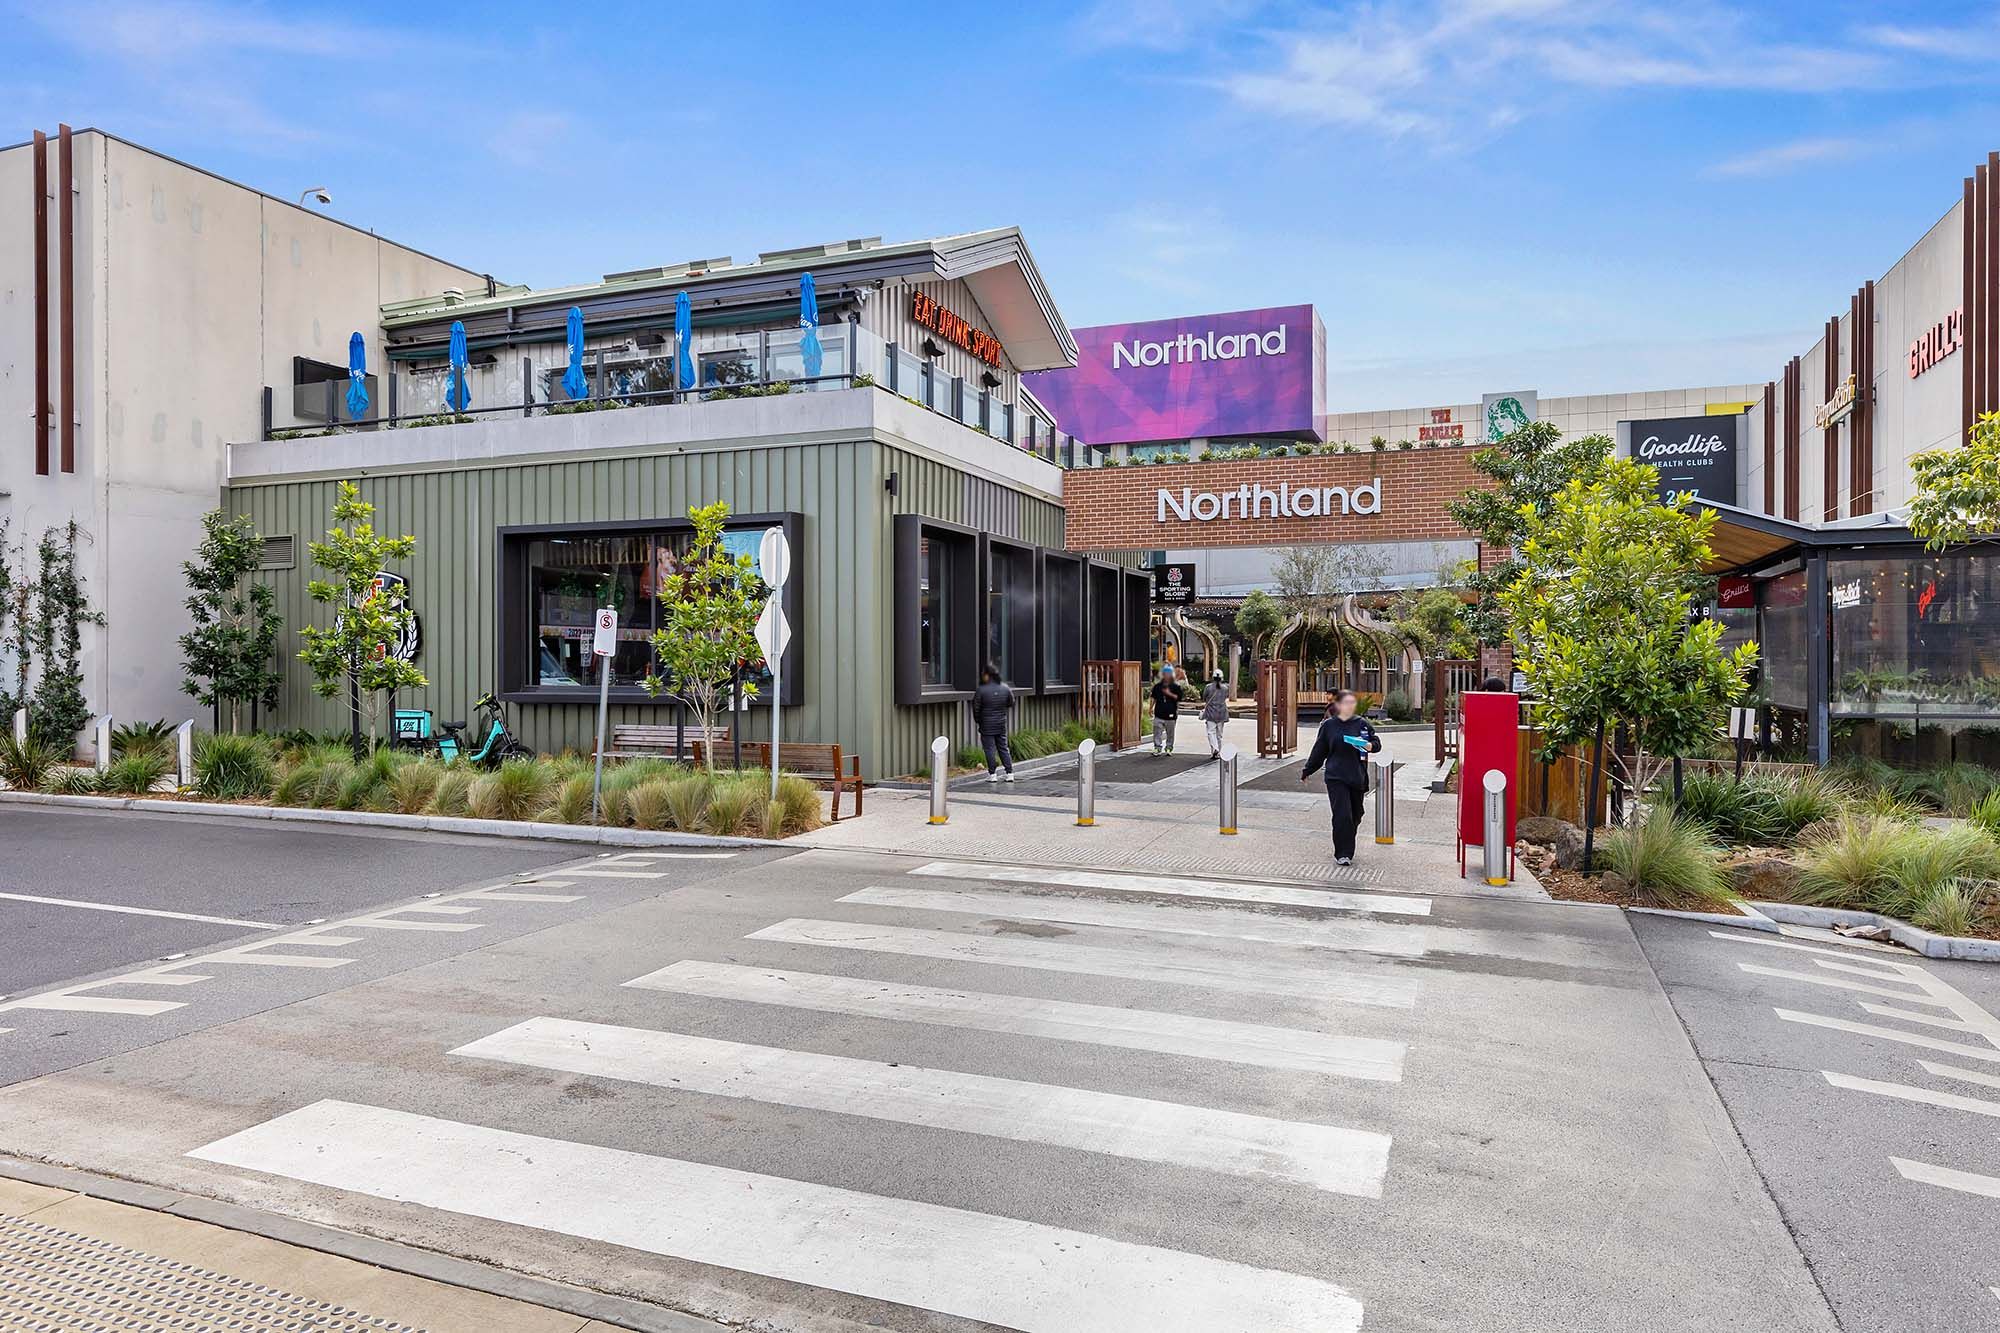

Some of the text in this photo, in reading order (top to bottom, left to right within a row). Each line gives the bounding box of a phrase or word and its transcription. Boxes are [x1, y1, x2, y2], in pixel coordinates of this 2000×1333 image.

[938, 305, 971, 350] DRINK.
[972, 327, 1002, 368] SPORT.
[1112, 324, 1287, 369] Northland
[1431, 409, 1451, 423] THE
[1651, 458, 1714, 468] HEALTH CLUBS
[1157, 477, 1382, 522] Northland
